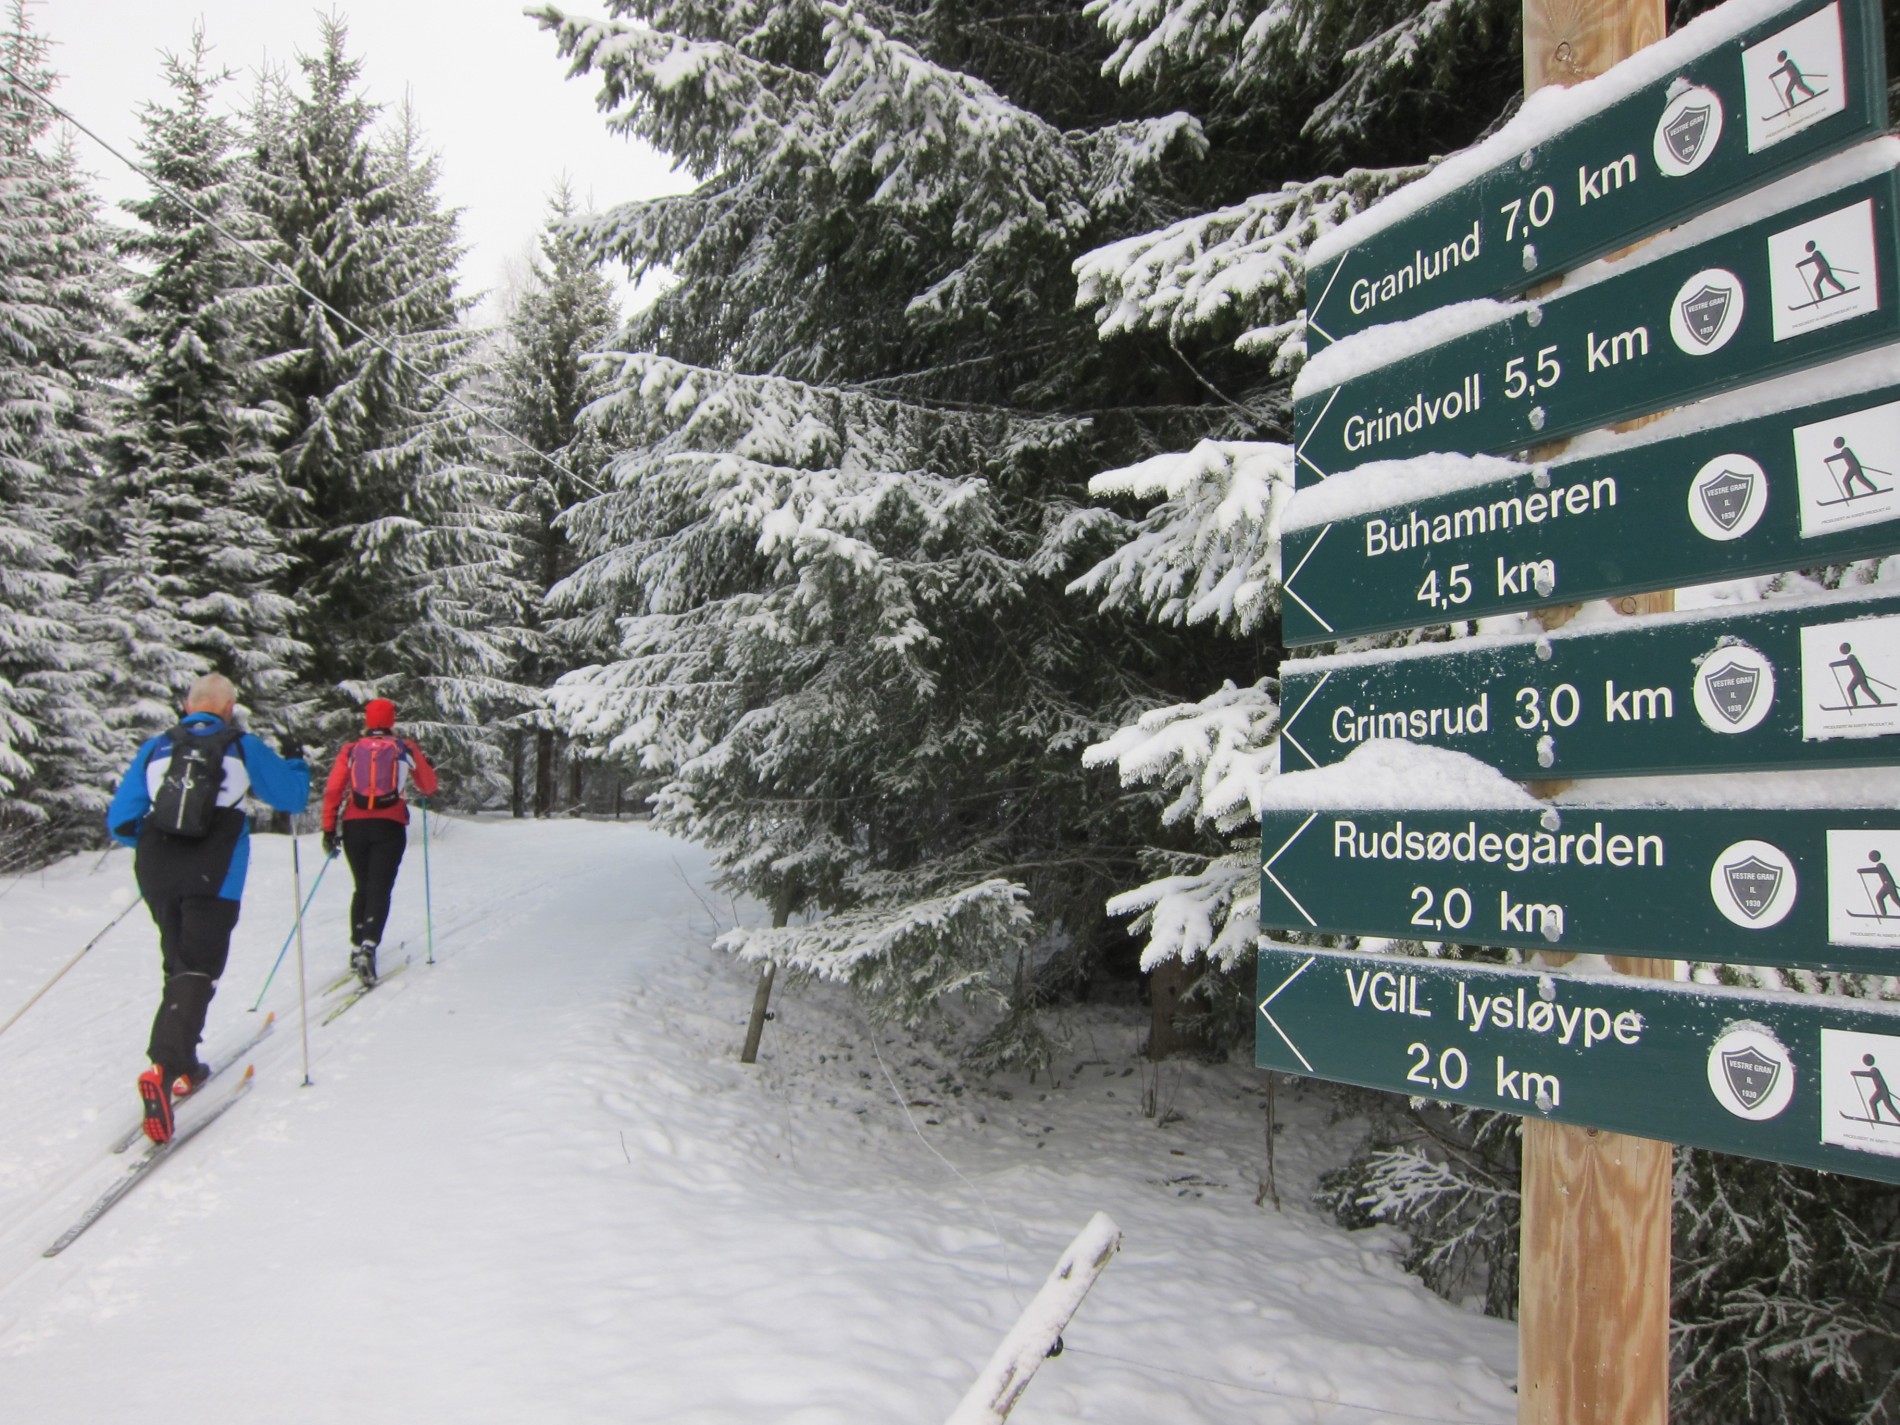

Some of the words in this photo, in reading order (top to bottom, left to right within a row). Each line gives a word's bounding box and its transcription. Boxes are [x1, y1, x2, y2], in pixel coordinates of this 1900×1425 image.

[1690, 114, 1705, 129] GRAN
[1349, 220, 1480, 315] Granlund
[1501, 185, 1555, 242] 7,0
[1579, 153, 1636, 206] km
[1688, 300, 1709, 313] VESTRE
[1709, 296, 1725, 307] GRAN
[1344, 373, 1480, 451] Grindvoll
[1504, 345, 1561, 400] 5,5
[1587, 325, 1648, 373] km
[1706, 486, 1730, 497] VESTRE
[1730, 483, 1747, 492] GRAN
[1366, 476, 1617, 557] Buhammeren
[1417, 562, 1472, 611] 4,5
[1497, 556, 1555, 595] km
[1713, 677, 1736, 687] VESTRE
[1736, 675, 1753, 685] GRAN
[1332, 693, 1488, 743] Grimsrud
[1514, 683, 1580, 733] 3,0
[1606, 678, 1673, 722] km
[1732, 872, 1755, 881] VESTRE
[1755, 873, 1775, 881] GRAN
[1411, 886, 1472, 931] 2,0
[1500, 890, 1564, 934] km
[1346, 969, 1432, 1017] VGIL
[1458, 981, 1642, 1047] lysløype
[1406, 1042, 1468, 1090] 2,0
[1497, 1055, 1560, 1106] km
[1729, 1060, 1754, 1071] VESTRE
[1754, 1064, 1773, 1075] GRAN
